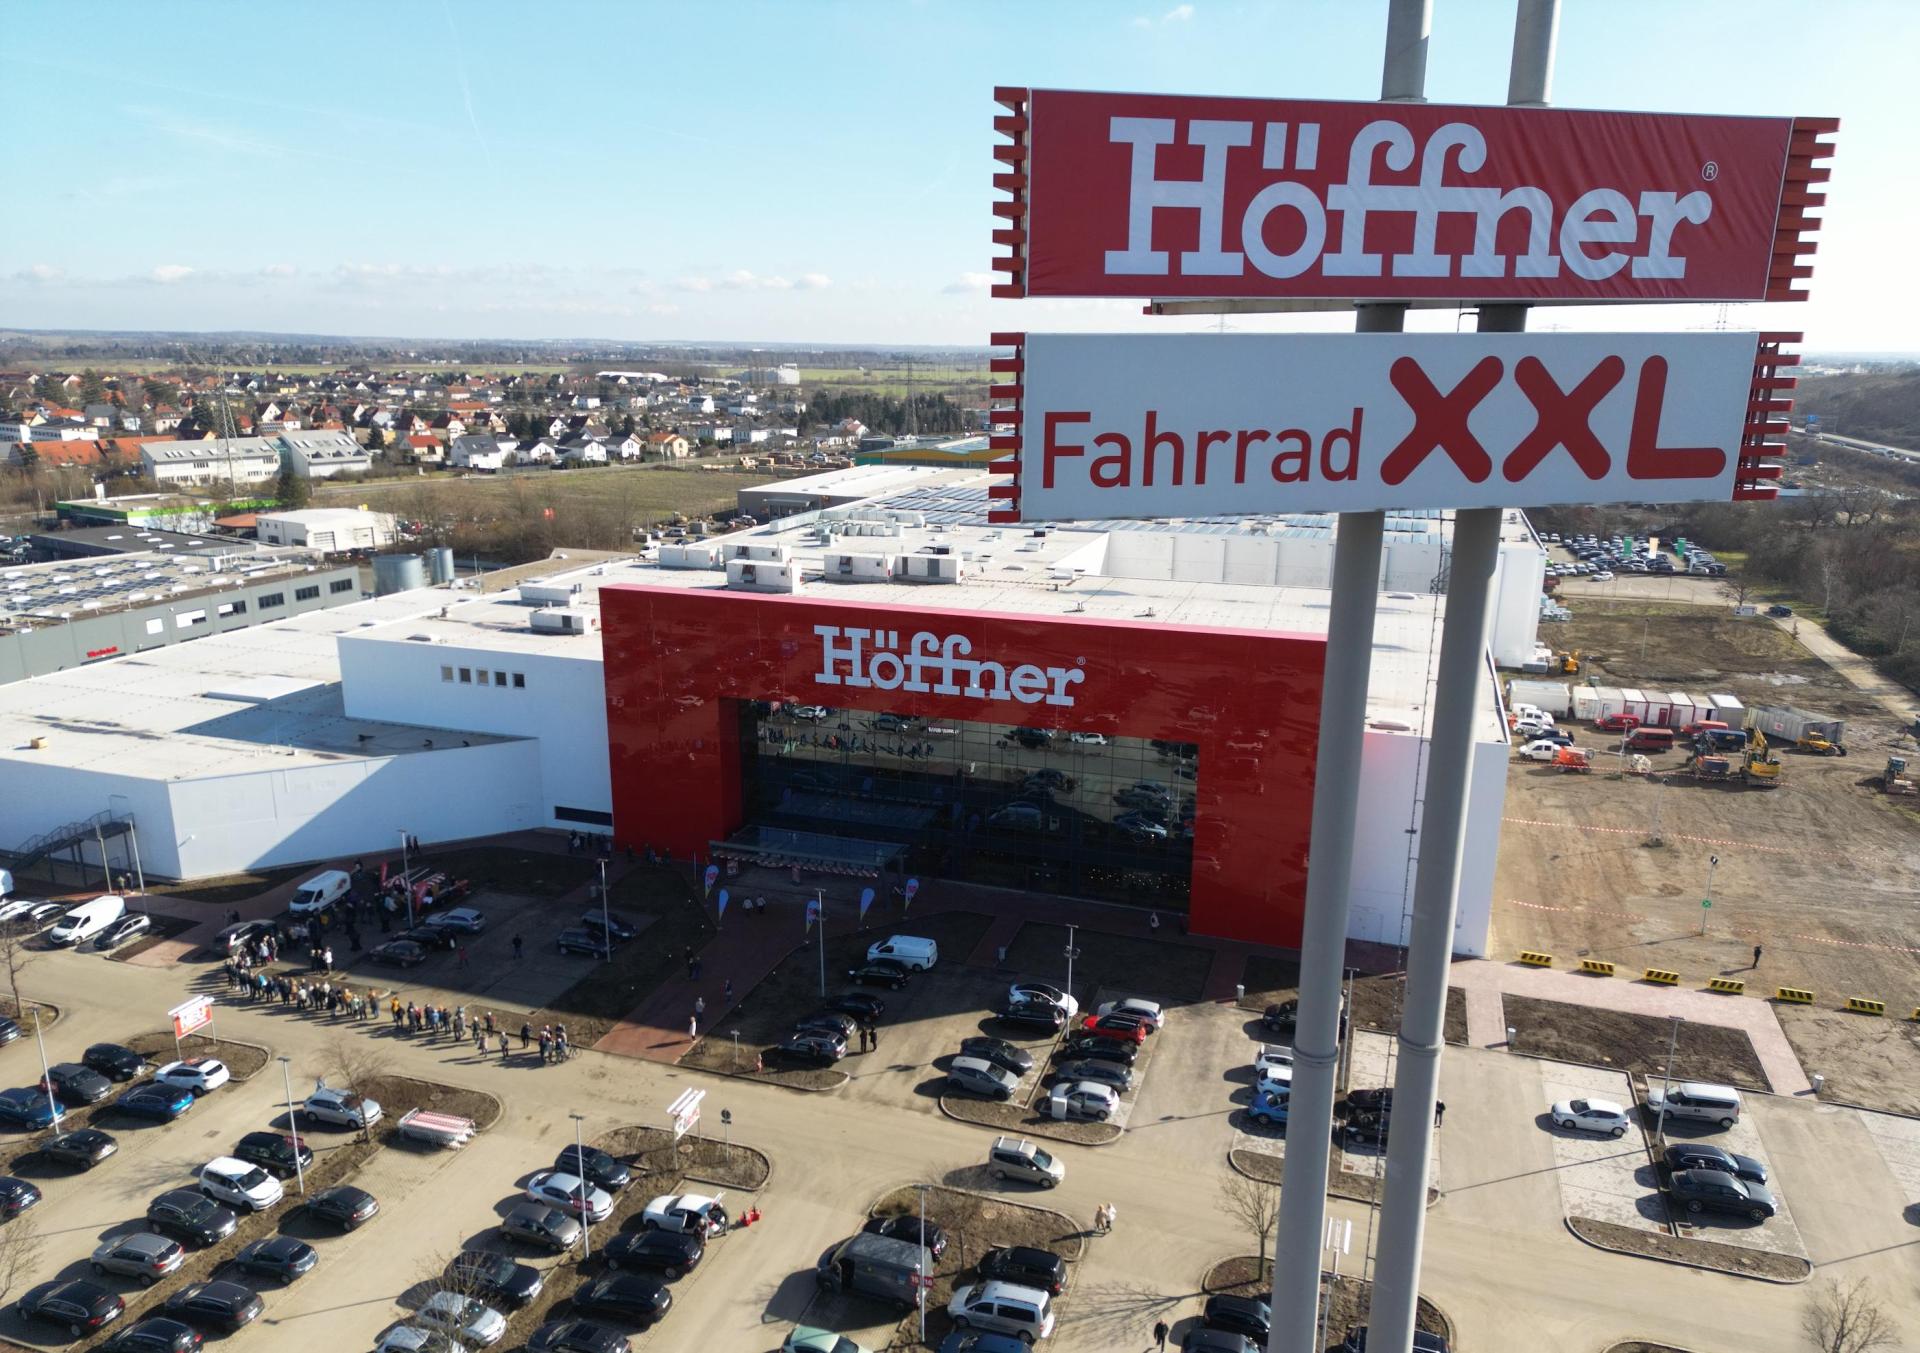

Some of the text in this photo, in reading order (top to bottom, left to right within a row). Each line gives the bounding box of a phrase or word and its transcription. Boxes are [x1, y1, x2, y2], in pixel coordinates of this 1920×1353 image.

[1104, 116, 1713, 280] Höffner
[1042, 355, 1727, 489] Fahrrad XXL
[814, 625, 1086, 706] Höffner
